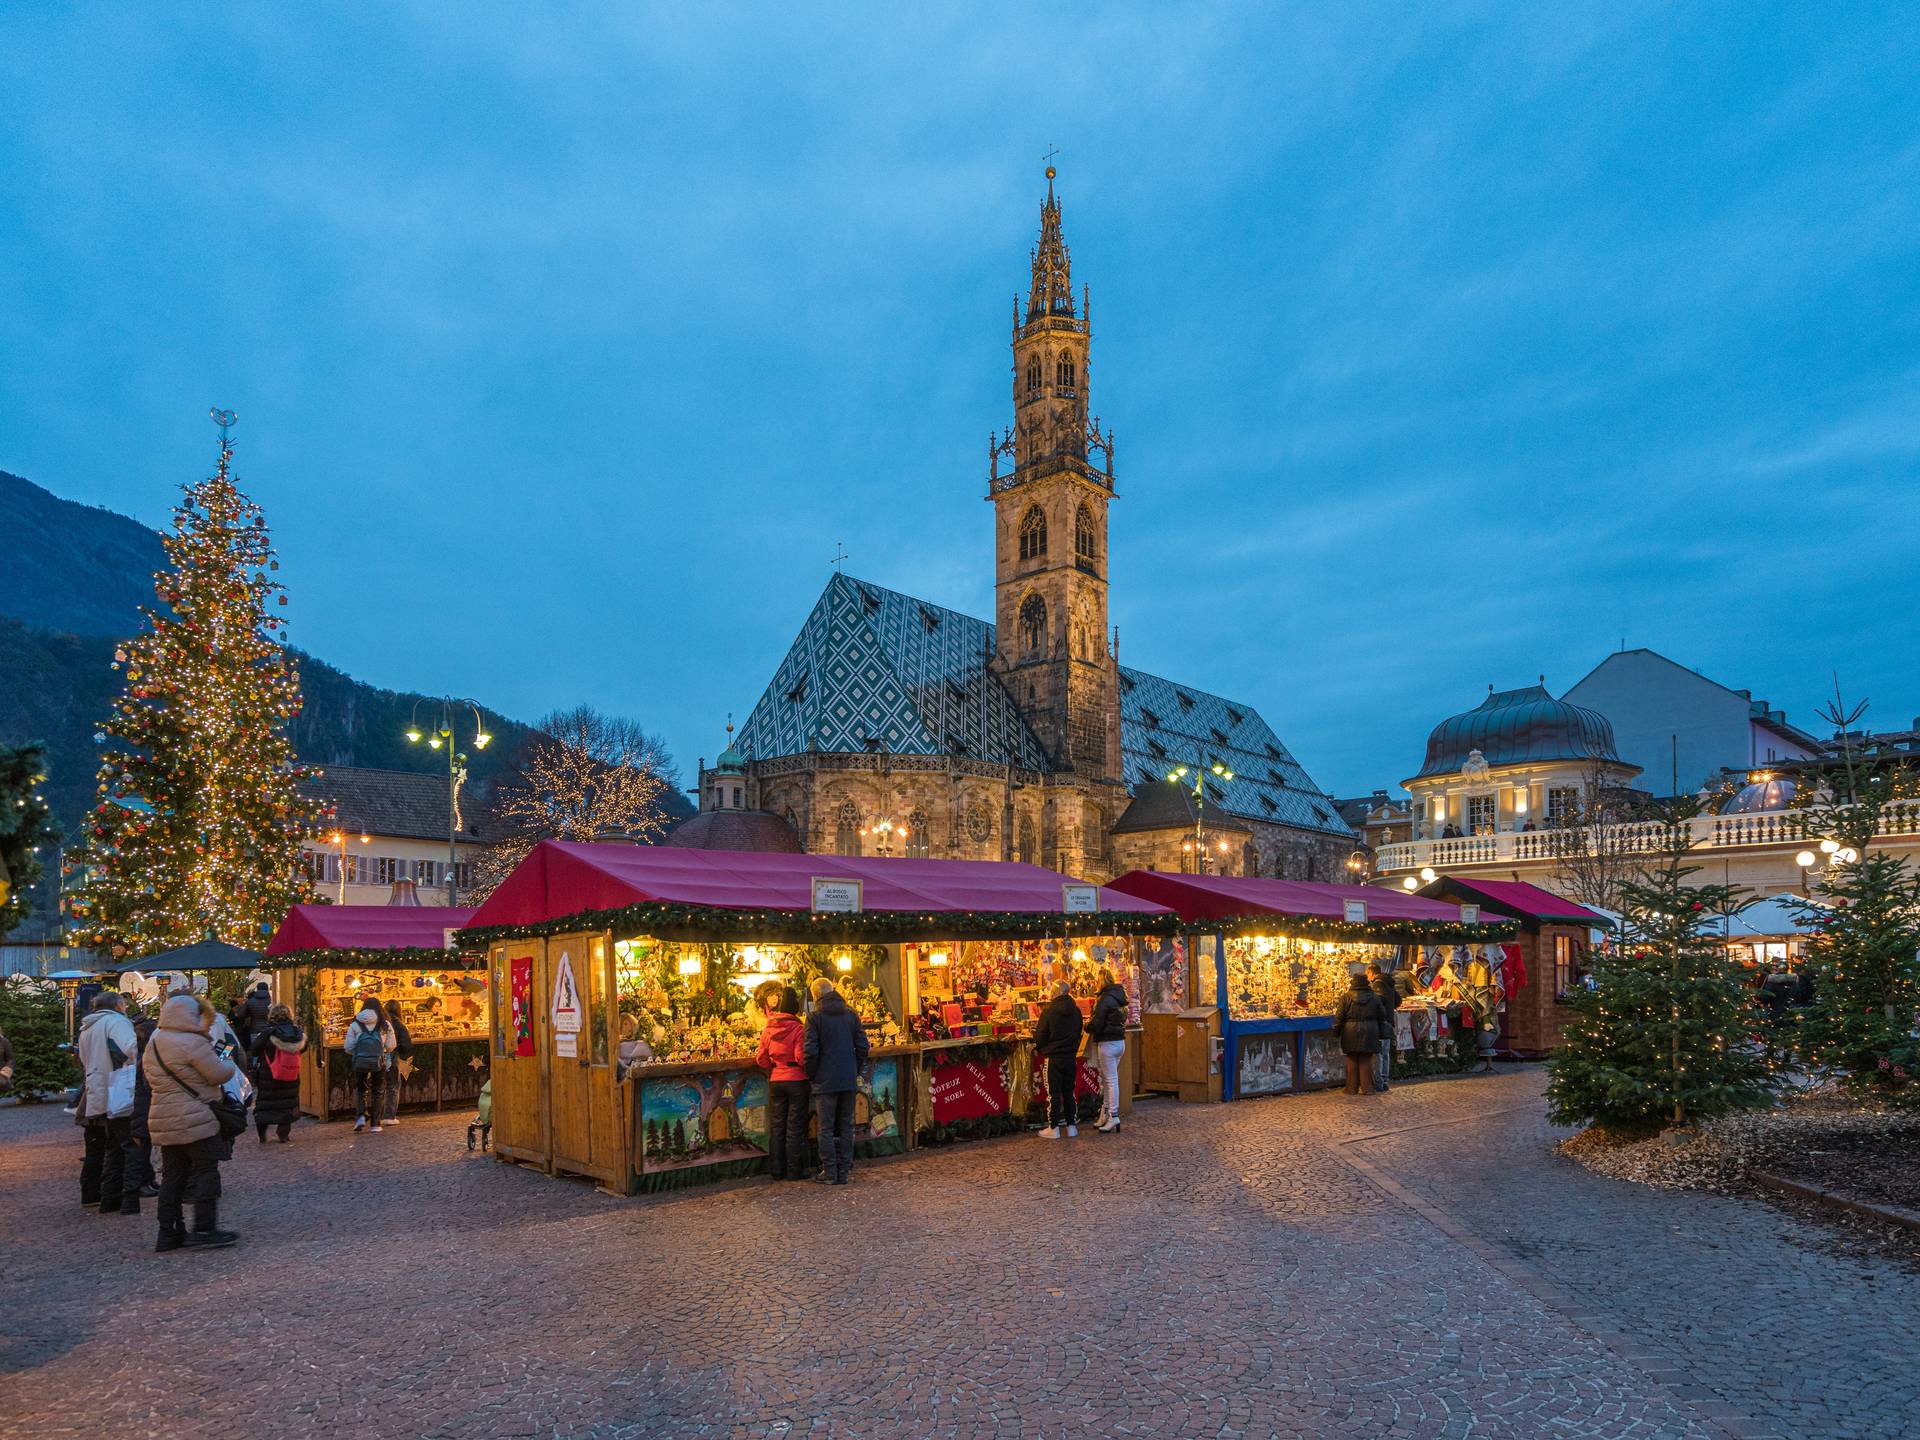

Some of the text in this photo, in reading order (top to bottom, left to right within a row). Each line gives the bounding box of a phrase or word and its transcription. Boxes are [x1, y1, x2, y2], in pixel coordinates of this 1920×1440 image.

[966, 1062, 987, 1083] FELIZ
[932, 1077, 961, 1095] JOYEUX
[944, 1090, 965, 1104] NOEL
[973, 1083, 1000, 1111] NAVIDAD
